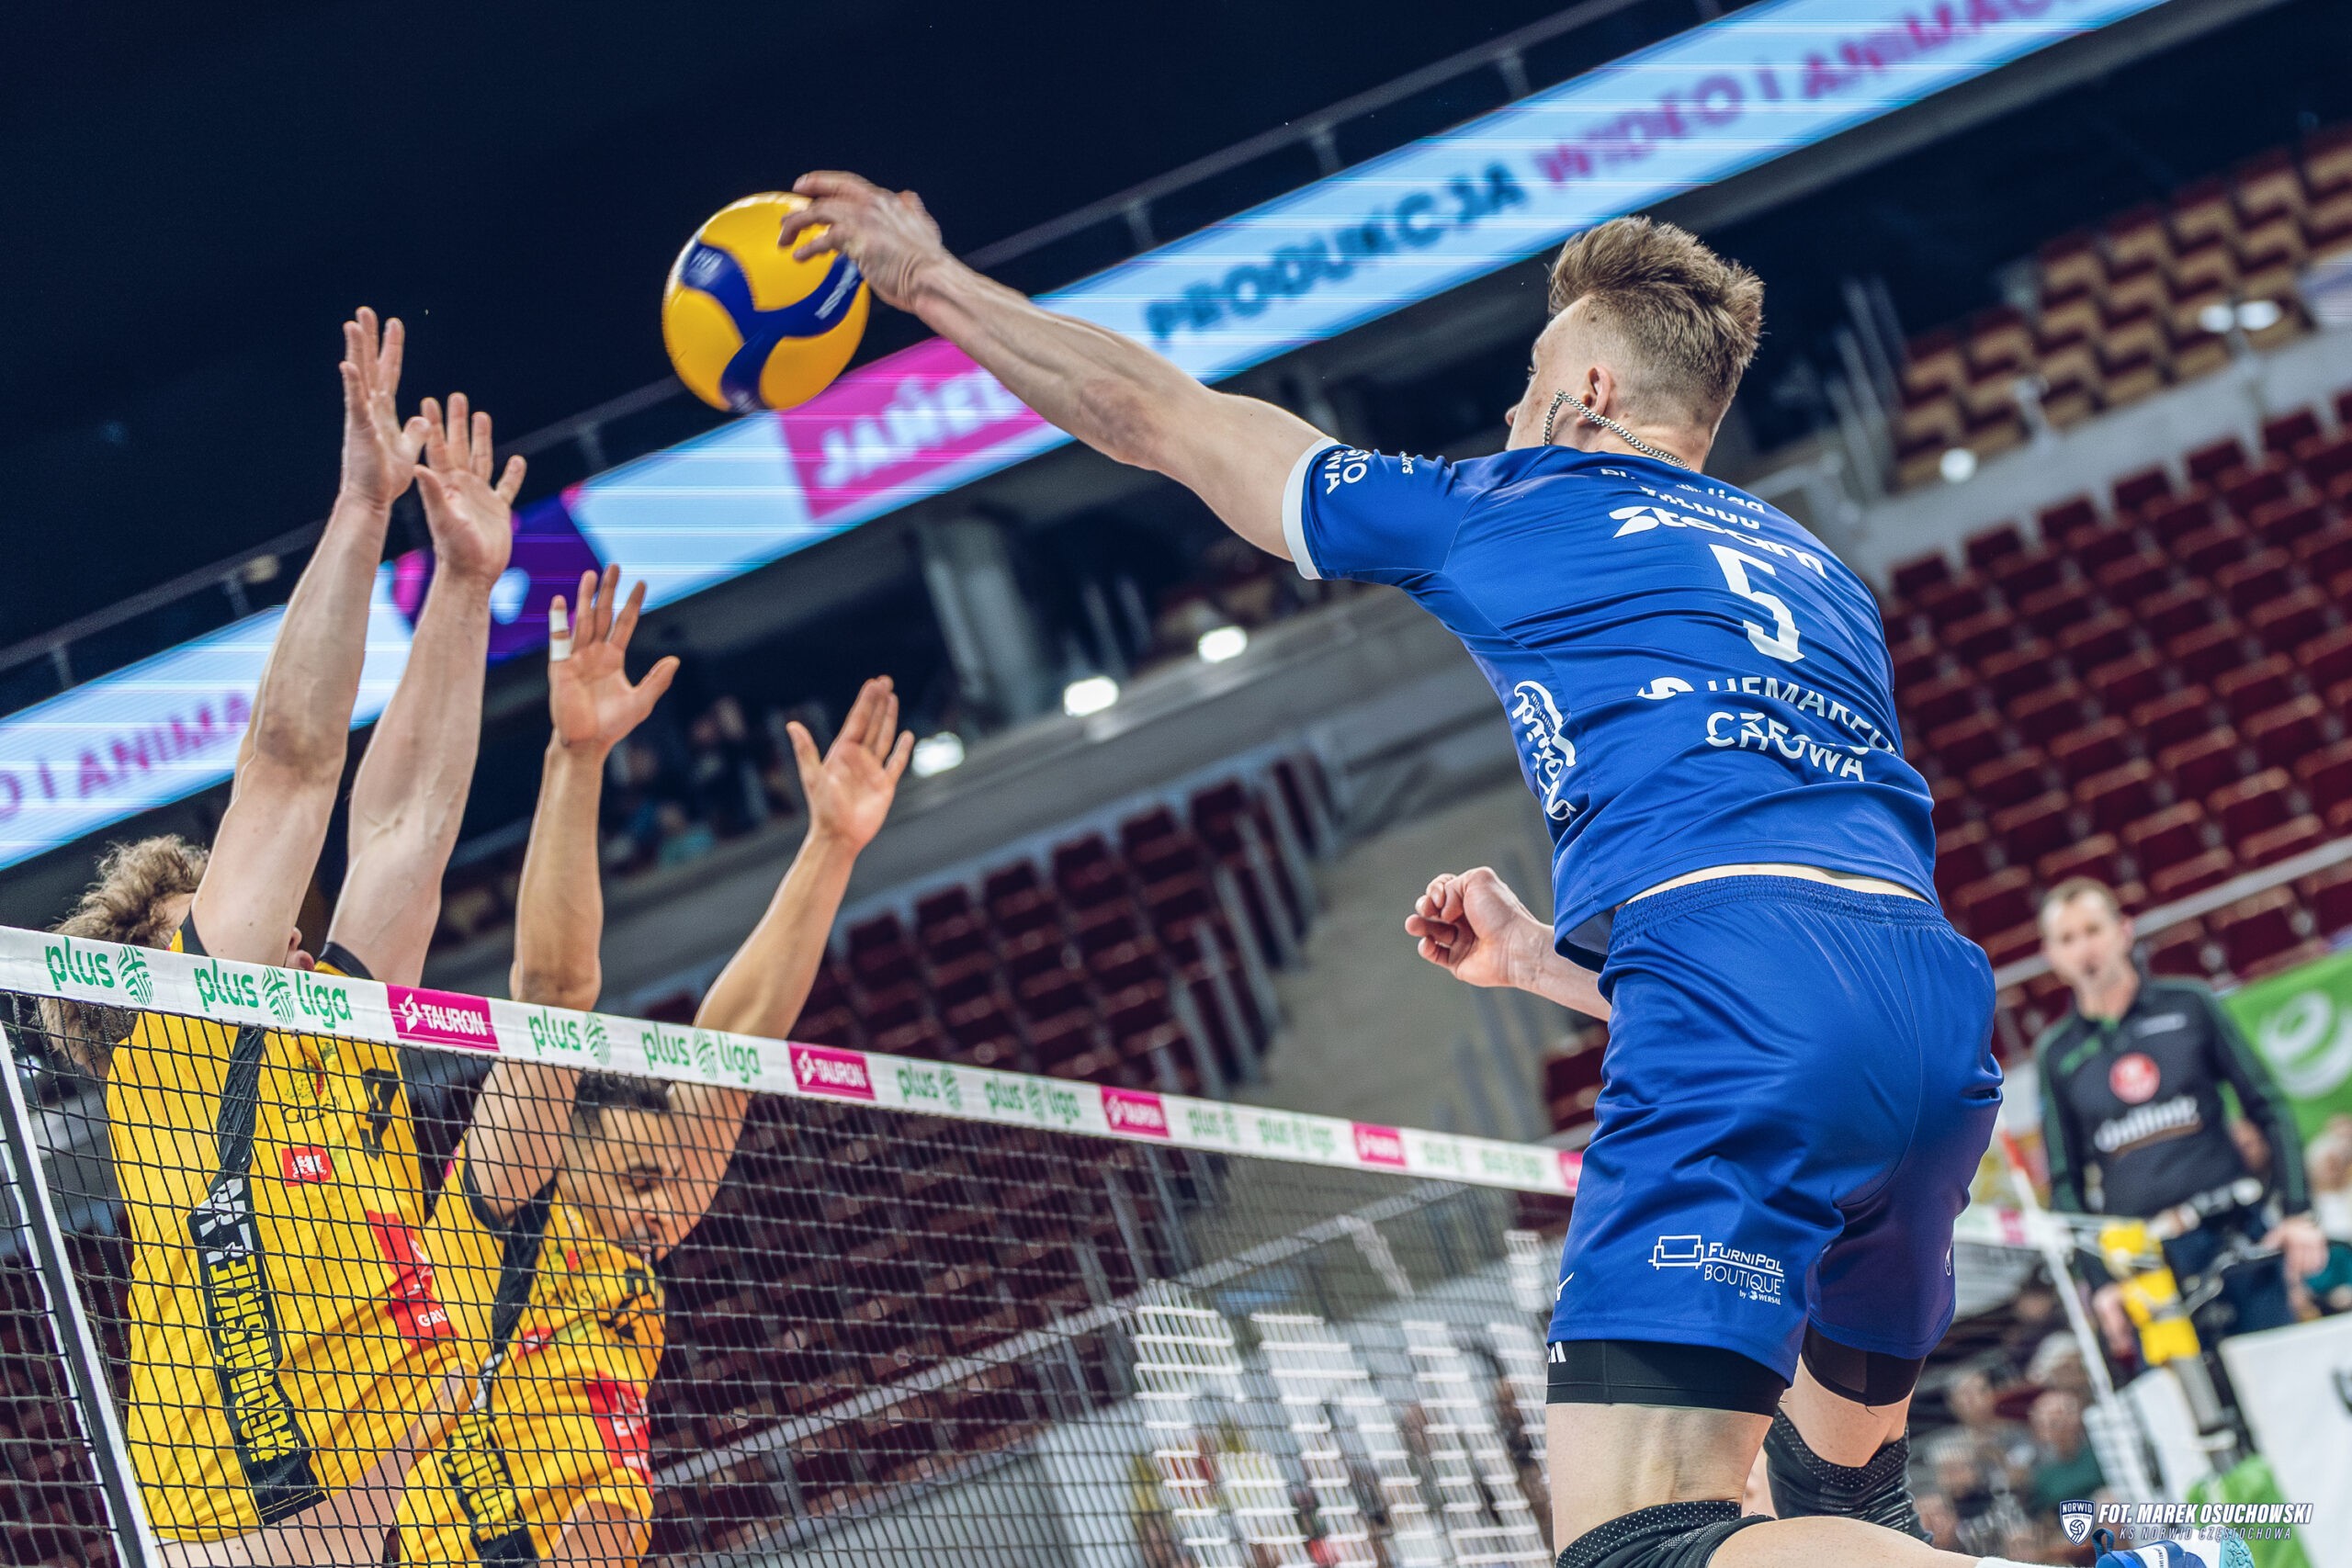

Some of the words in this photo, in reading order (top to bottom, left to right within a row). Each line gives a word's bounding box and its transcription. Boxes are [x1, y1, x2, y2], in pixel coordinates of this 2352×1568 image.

[1708, 544, 1805, 663] 5
[45, 937, 115, 991] plus
[194, 959, 261, 1012] plus
[296, 972, 353, 1029] liga
[420, 1003, 488, 1036] TAURON
[528, 1007, 582, 1055] plus
[642, 1023, 691, 1071] plus
[718, 1030, 763, 1084] liga
[816, 1058, 866, 1089] TAURON
[1704, 1264, 1782, 1296] BOUTIQUE
[1739, 1290, 1747, 1299] by
